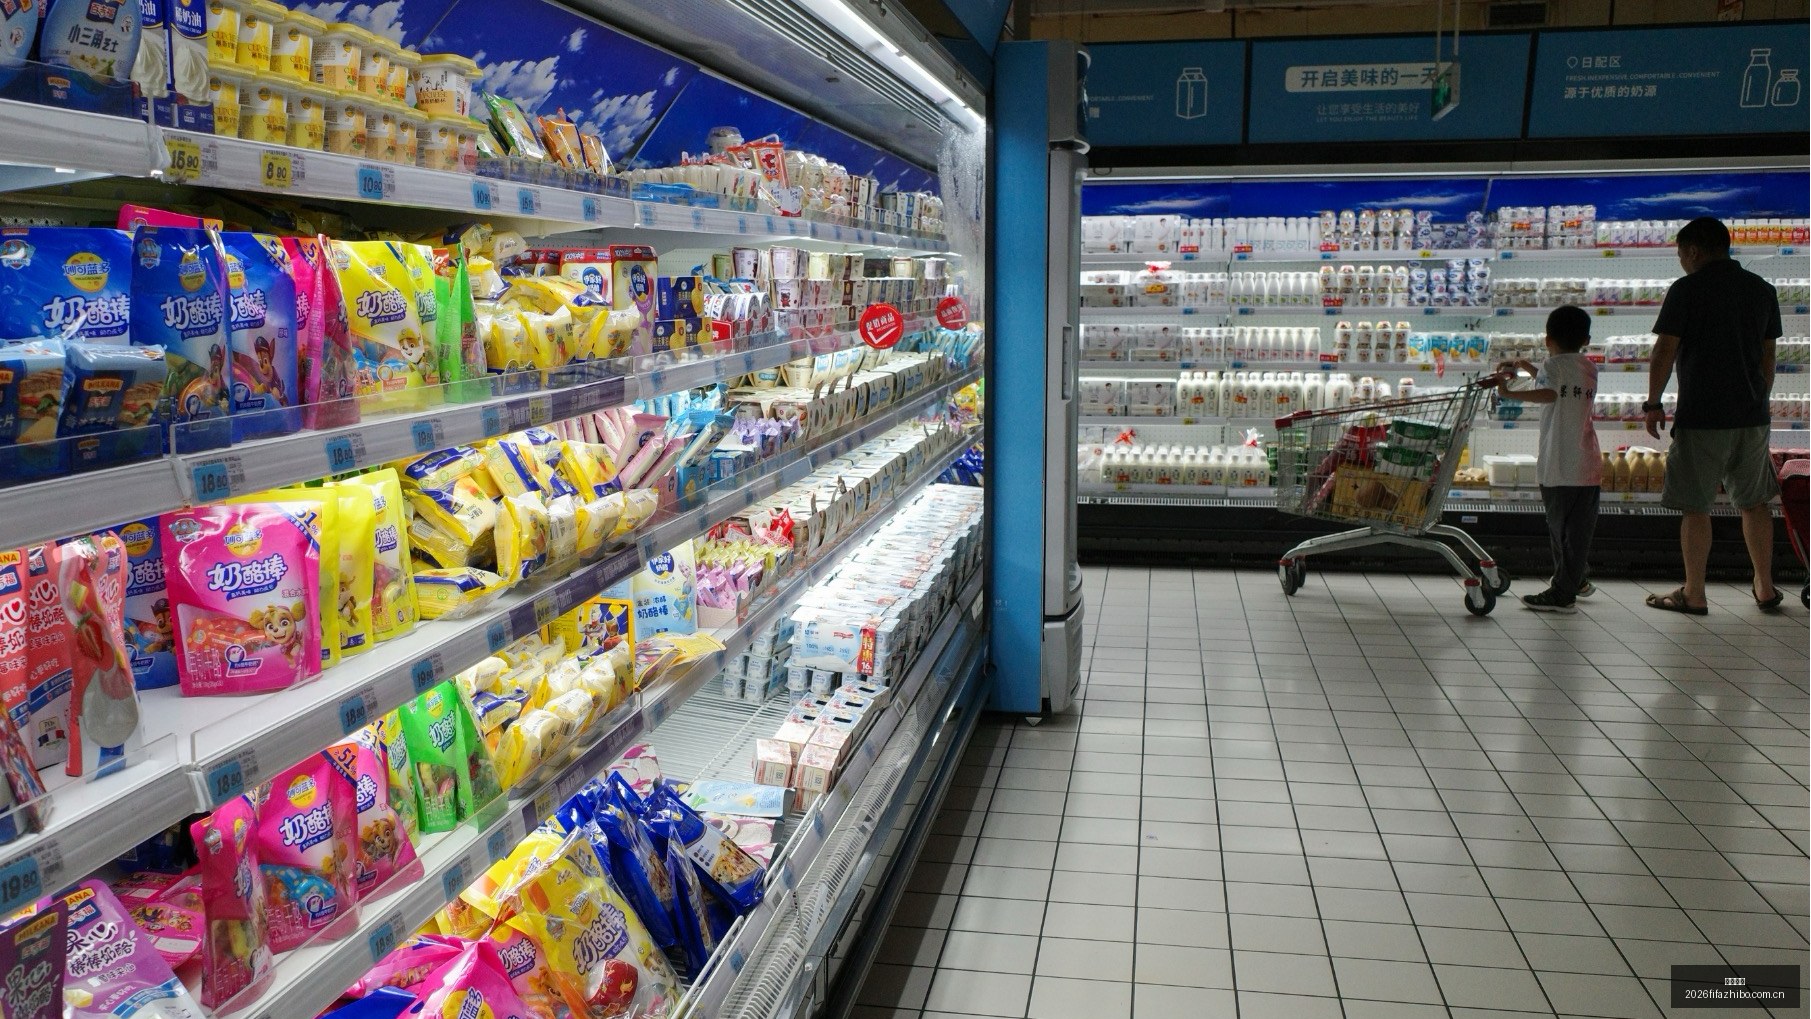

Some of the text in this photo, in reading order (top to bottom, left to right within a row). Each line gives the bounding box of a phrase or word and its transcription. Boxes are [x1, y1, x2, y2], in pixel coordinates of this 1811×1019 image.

[175, 6, 202, 28] 稀奶油
[68, 23, 120, 53] 小三角芝士
[1582, 56, 1621, 68] 日配区
[1301, 67, 1438, 87] 开启美味的一天
[1564, 85, 1657, 99] 源于优质的奶源
[1316, 102, 1420, 116] 让您享受生活的美好
[43, 294, 130, 328] 奶酪棒
[160, 292, 223, 330] 奶酪棒
[357, 290, 407, 318] 奶酪棒
[225, 528, 263, 545] 妙可蓝多
[207, 553, 288, 592] 奶酪棒
[637, 604, 668, 619] 奶酪棒
[573, 902, 627, 975] 奶酪棒
[69, 940, 133, 976] 棒棒奶酪
